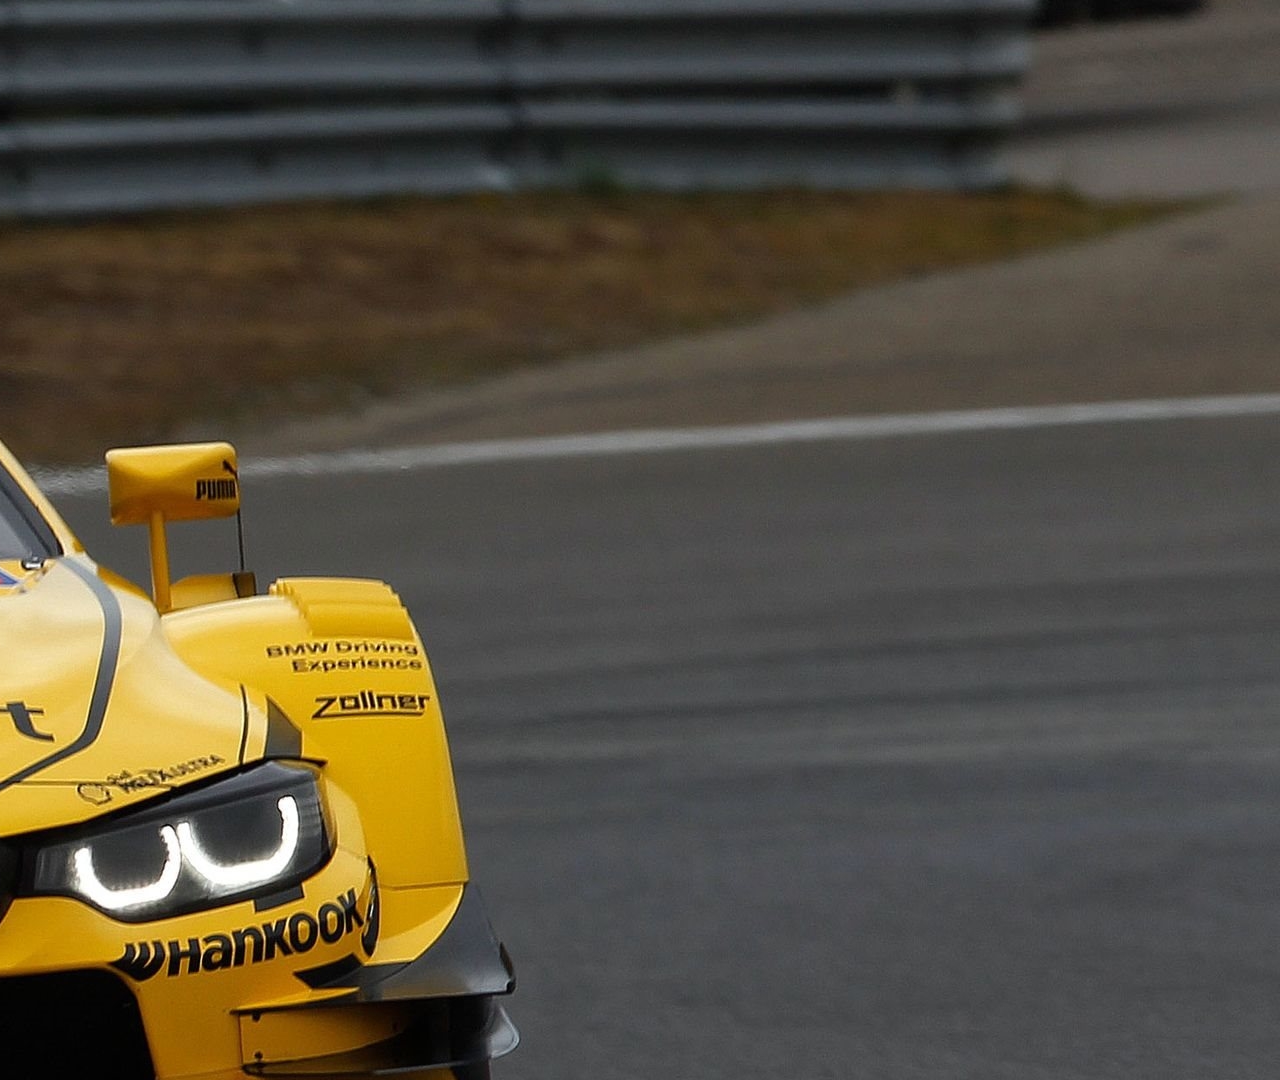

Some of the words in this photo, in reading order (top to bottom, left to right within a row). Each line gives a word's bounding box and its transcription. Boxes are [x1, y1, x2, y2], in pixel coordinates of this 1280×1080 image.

[266, 642, 328, 658] BMW
[335, 640, 419, 656] Driving
[291, 656, 423, 673] Experience
